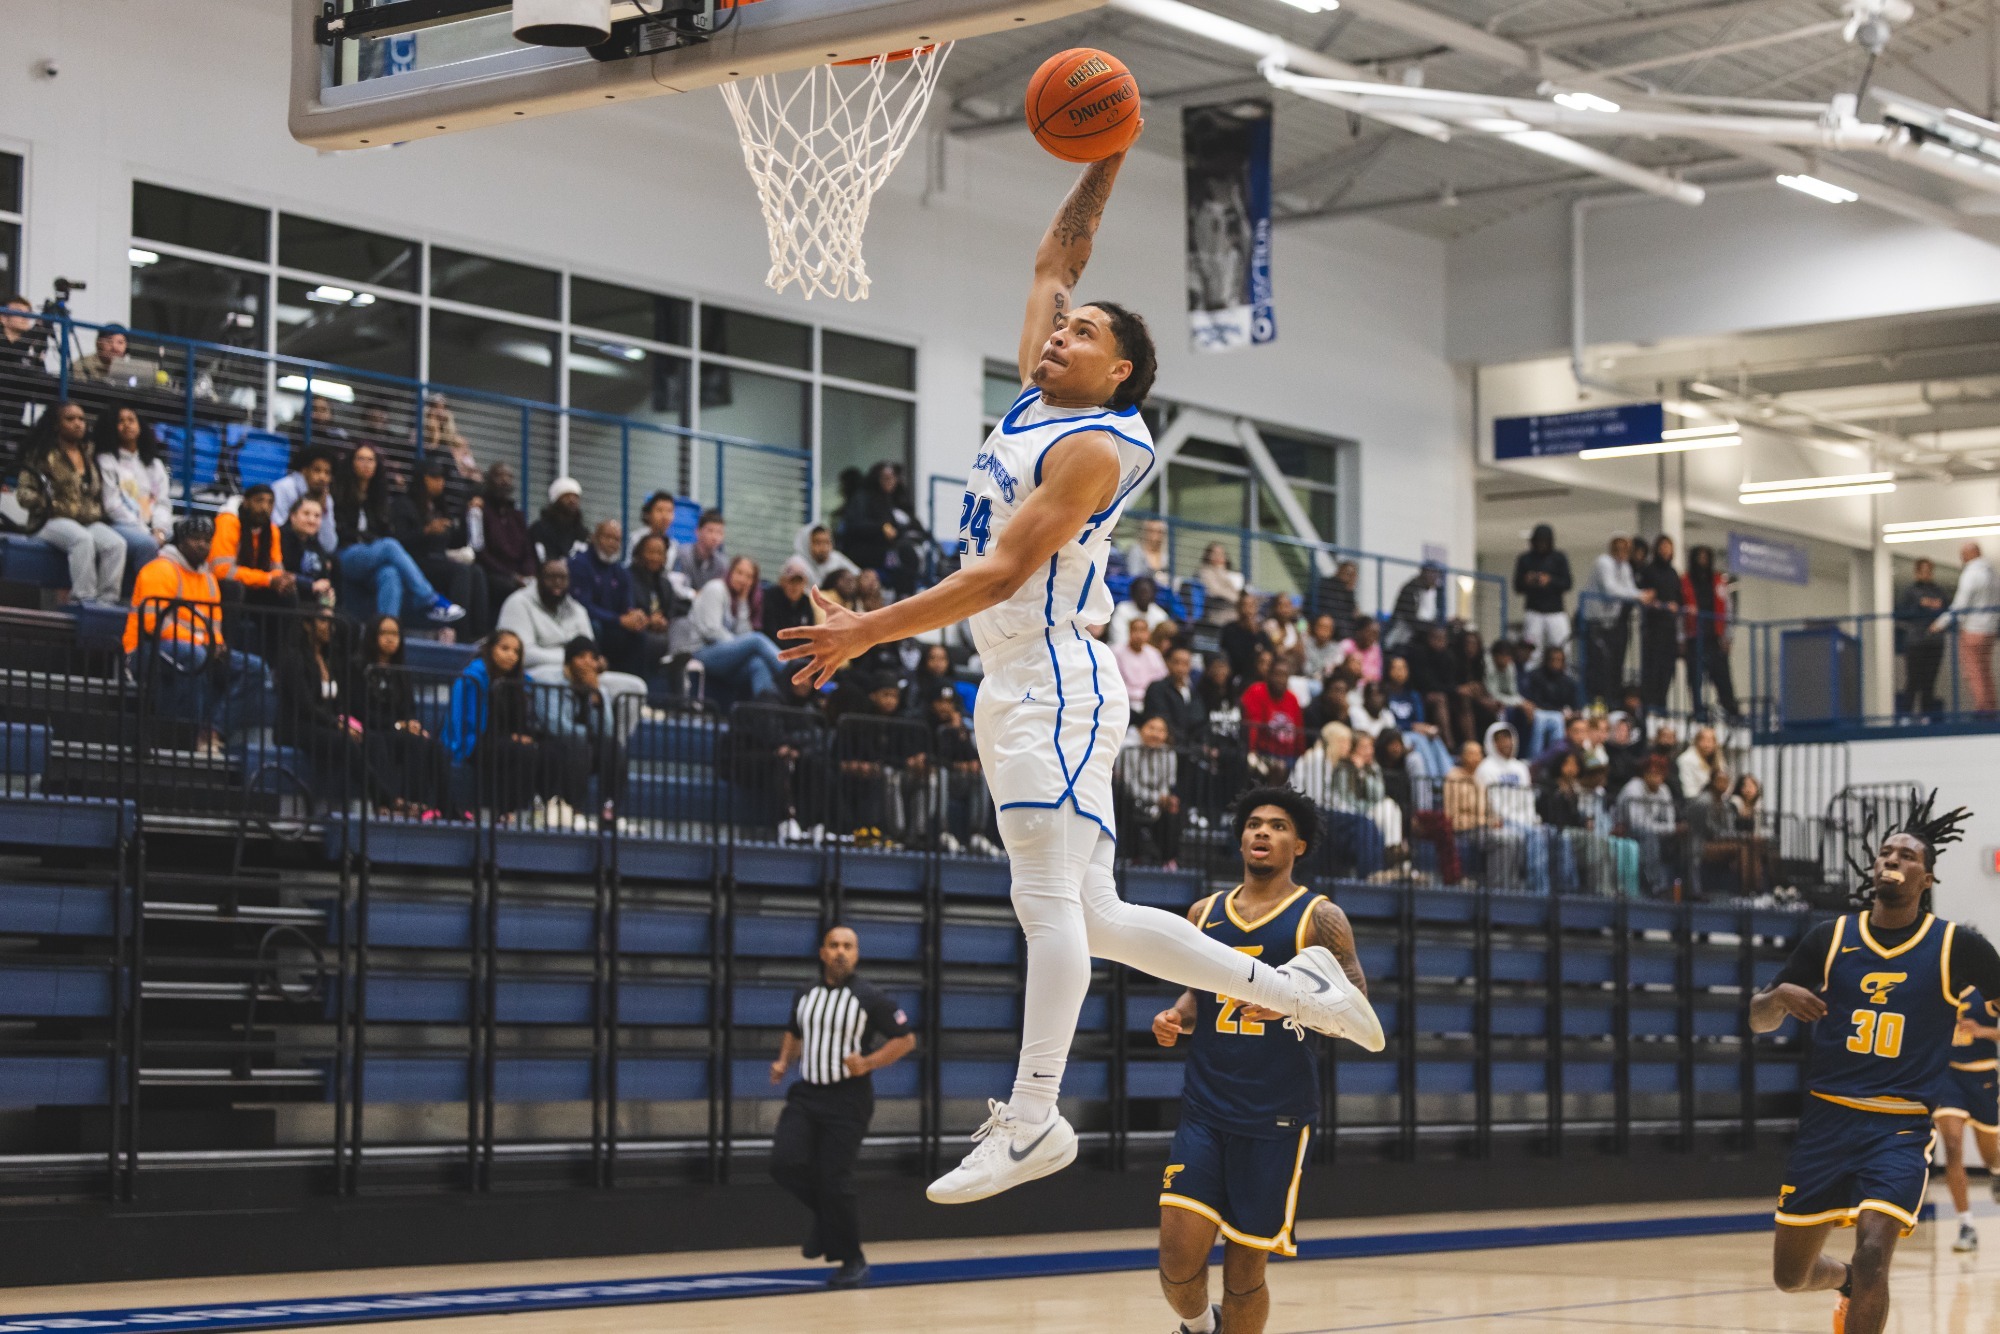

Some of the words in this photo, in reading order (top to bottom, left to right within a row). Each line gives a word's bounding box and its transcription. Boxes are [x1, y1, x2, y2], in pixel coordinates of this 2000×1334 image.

[1068, 80, 1134, 127] SPALDING
[959, 490, 994, 556] 24
[1846, 1008, 1906, 1058] 30
